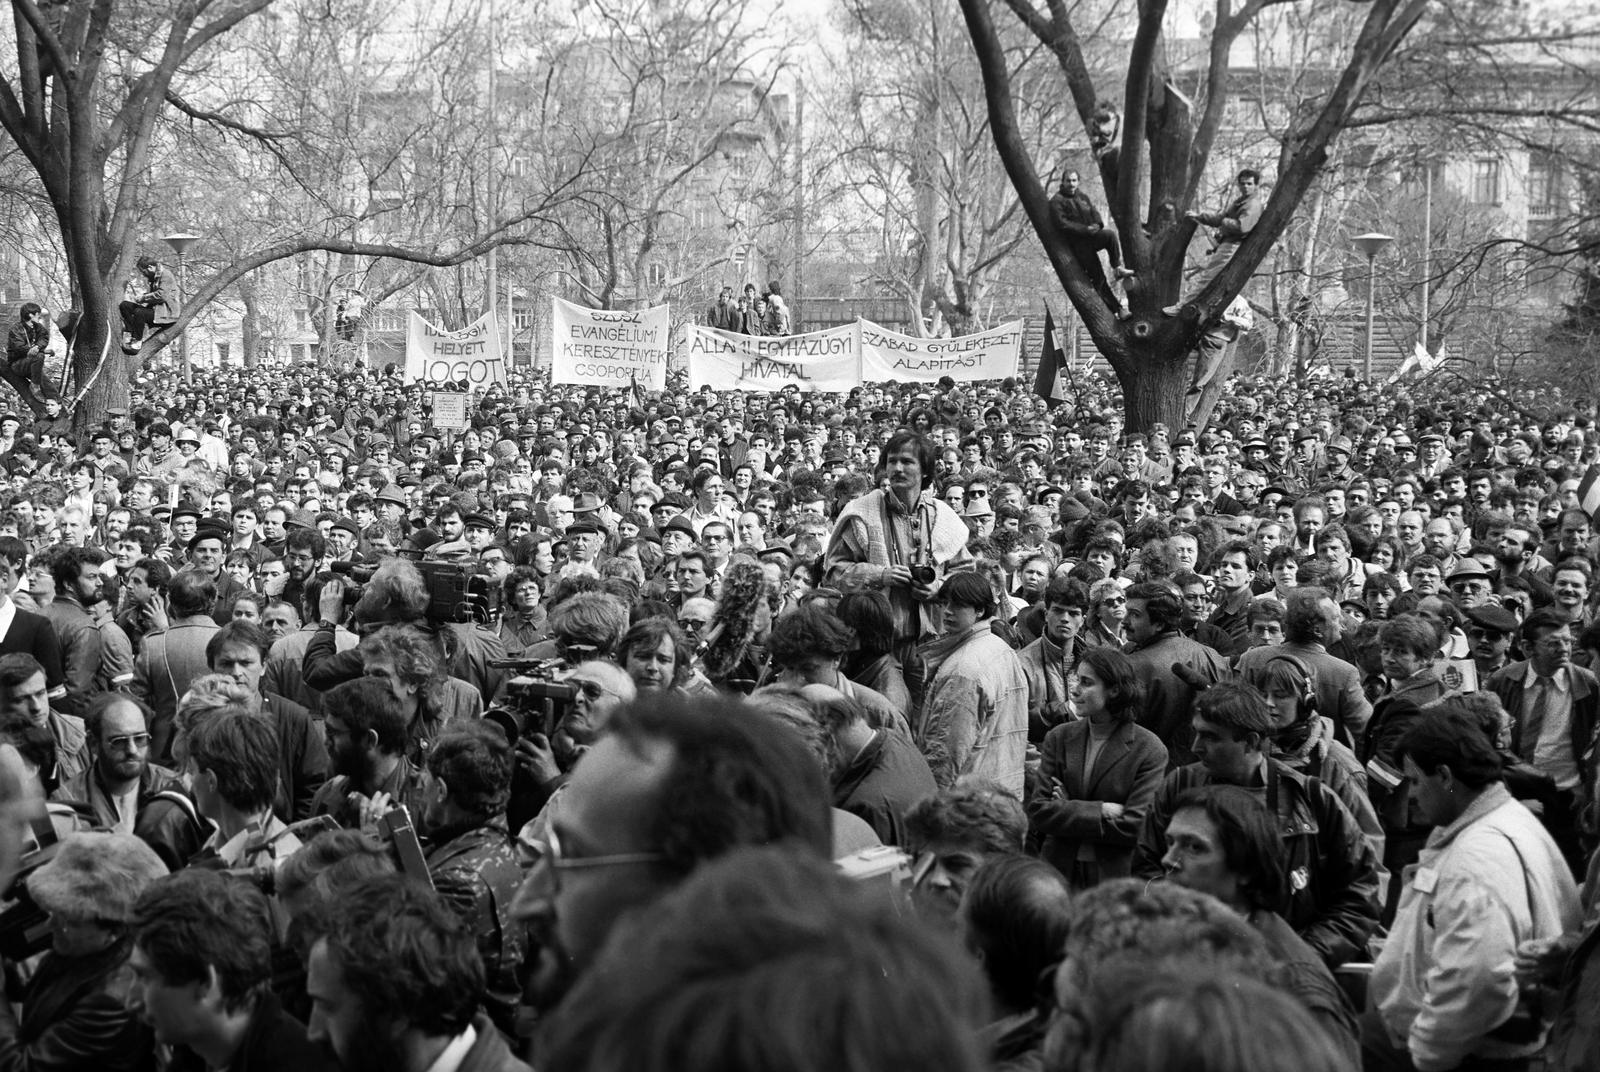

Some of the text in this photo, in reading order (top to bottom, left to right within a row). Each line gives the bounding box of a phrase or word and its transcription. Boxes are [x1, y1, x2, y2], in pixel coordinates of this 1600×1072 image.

[433, 341, 486, 356] HELYETT
[757, 332, 852, 357] EGYHÁZÜGYI
[861, 331, 1020, 353] SZABAD GYÜLEKEZET
[563, 343, 668, 364] KERESZTÉNYEK
[413, 357, 502, 383] JOGOT
[739, 358, 811, 380] HIVATAL
